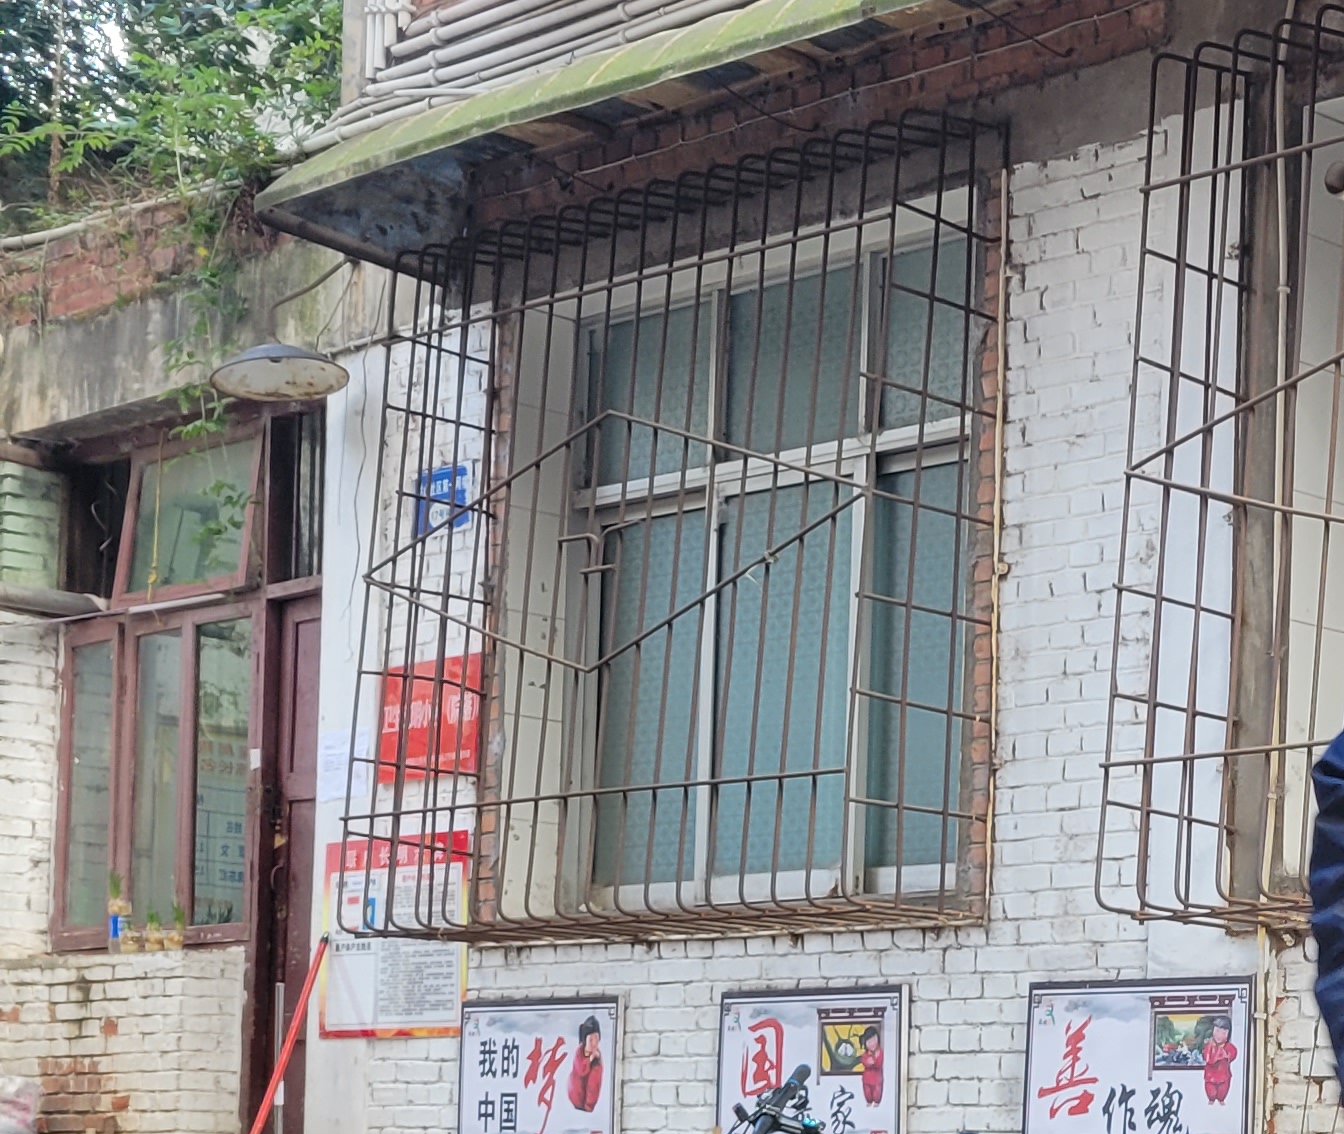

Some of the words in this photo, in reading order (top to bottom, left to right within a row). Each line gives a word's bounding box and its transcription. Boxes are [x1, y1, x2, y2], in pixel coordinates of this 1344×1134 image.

[478, 1037, 520, 1080] 我的
[741, 1018, 784, 1098] 国
[1038, 1013, 1099, 1120] 善
[477, 1091, 518, 1133] 中国
